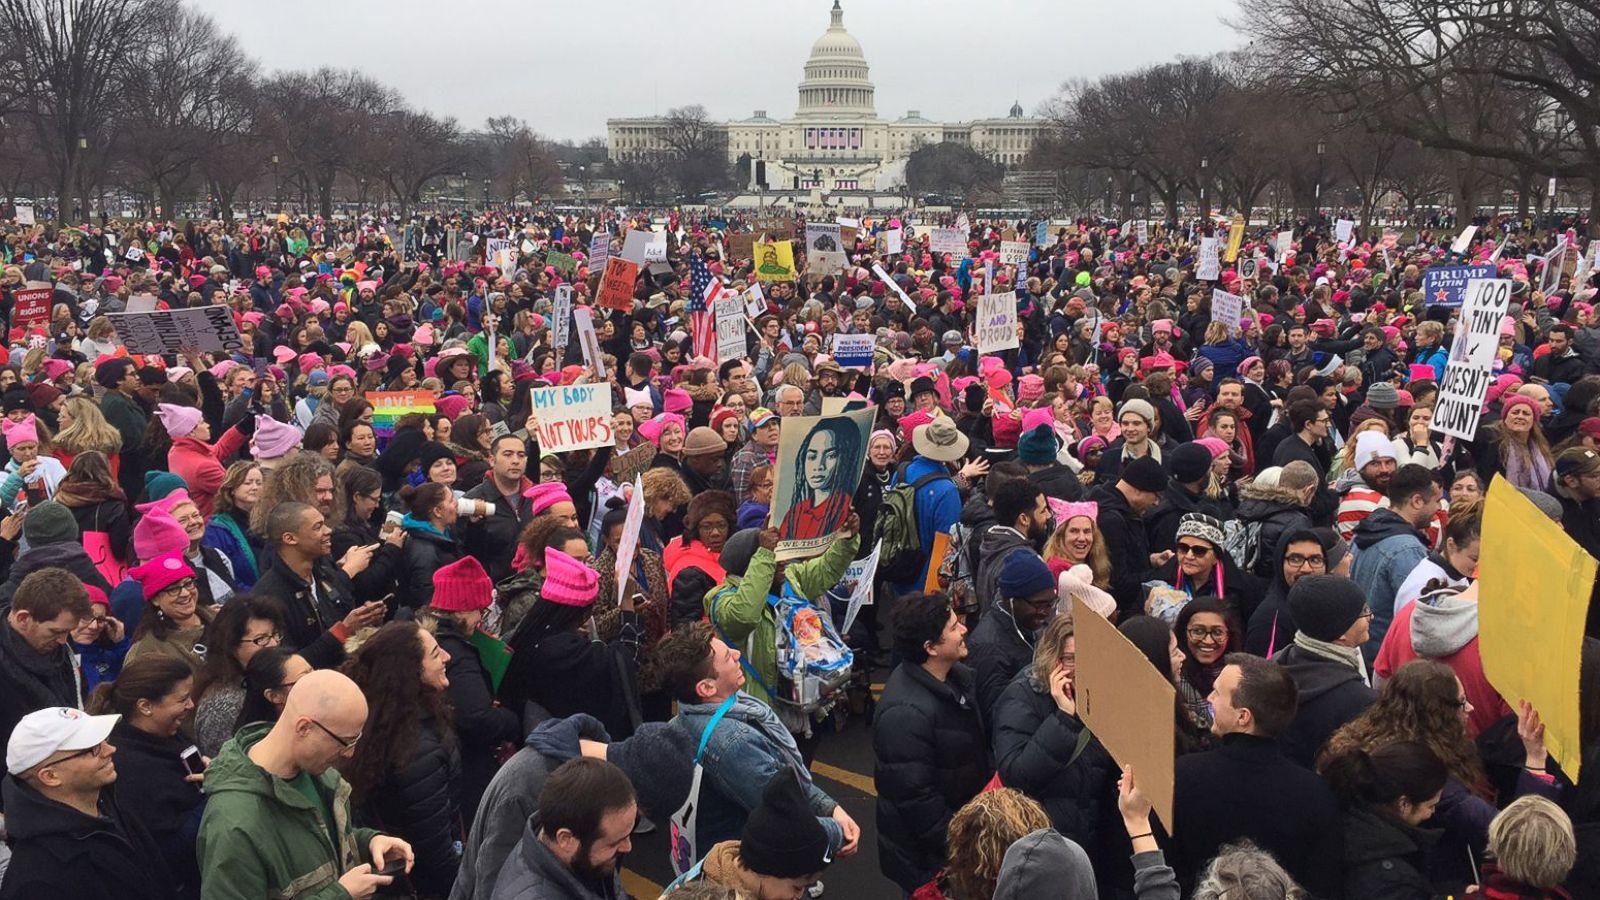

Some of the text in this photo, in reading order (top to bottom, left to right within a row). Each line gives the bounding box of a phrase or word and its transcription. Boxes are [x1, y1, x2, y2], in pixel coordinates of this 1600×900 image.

[486, 240, 511, 262] UNITE
[1429, 268, 1488, 281] TRUMP
[1430, 280, 1464, 288] PUTIN
[17, 292, 50, 302] UNIONS
[1473, 282, 1507, 307] TOO
[20, 306, 47, 316] RIGHTS
[990, 314, 1008, 327] AND
[203, 307, 243, 350] DEMAND
[1471, 310, 1504, 335] TINY
[107, 314, 140, 354] POWER
[980, 326, 1013, 348] PROUD
[1441, 365, 1490, 400] DOESN'T
[375, 395, 415, 409] LOVE
[533, 386, 594, 409] MY BODY
[1434, 397, 1480, 435] COUNT
[536, 416, 611, 449] NOT YOURS
[801, 539, 818, 547] THE
